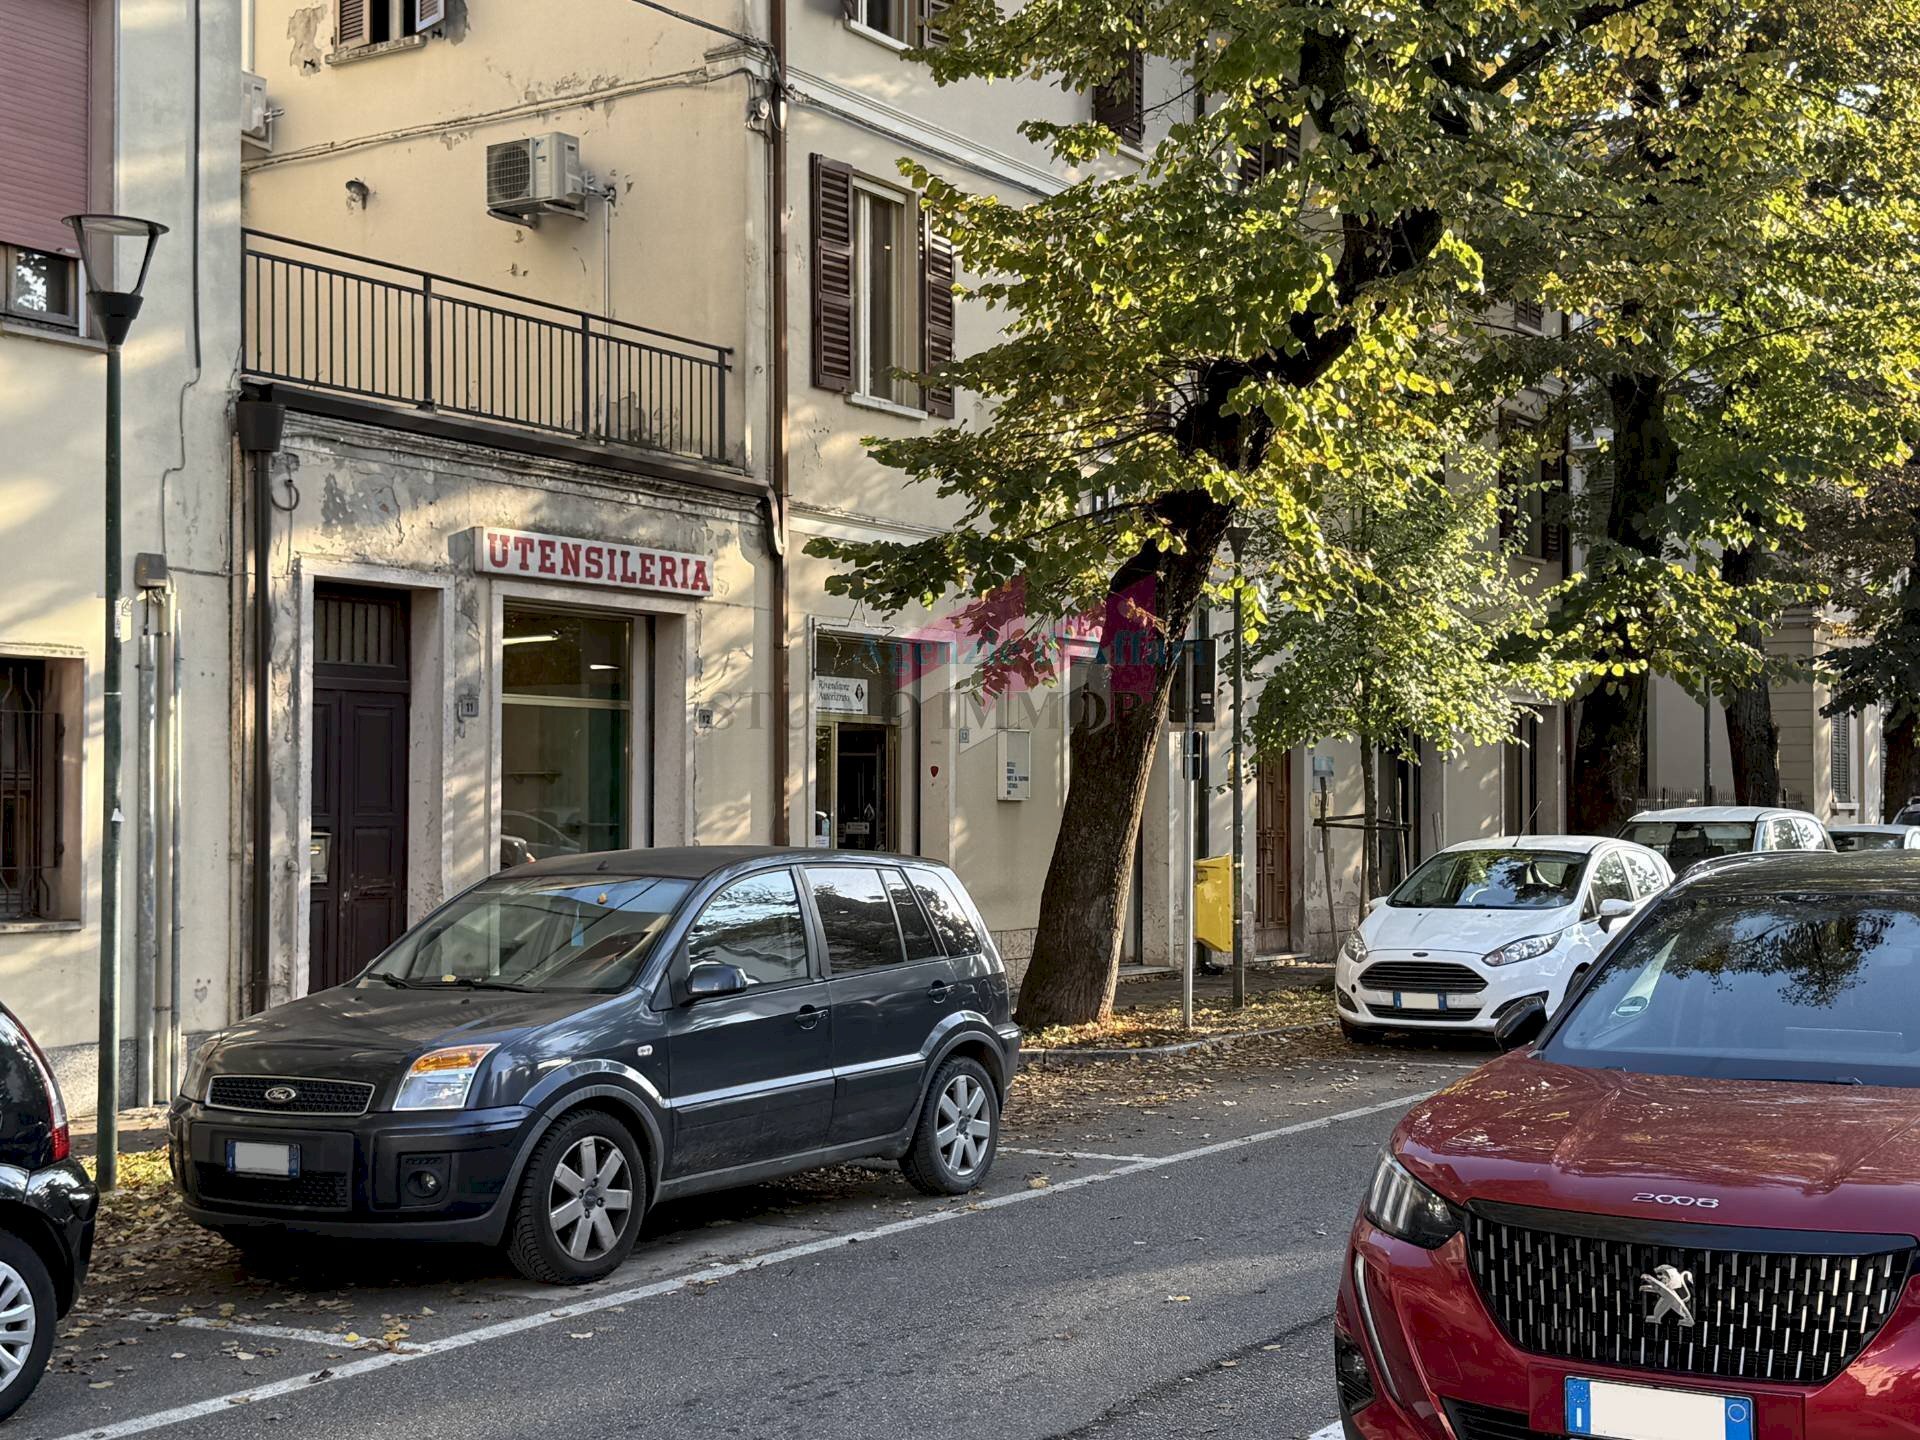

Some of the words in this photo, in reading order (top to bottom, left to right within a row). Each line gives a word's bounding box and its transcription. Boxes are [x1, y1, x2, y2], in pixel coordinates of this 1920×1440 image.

[488, 533, 711, 592] UTENSILERIA
[466, 702, 474, 713] 11
[702, 714, 711, 725] 12
[1632, 1192, 1719, 1209] 2008
